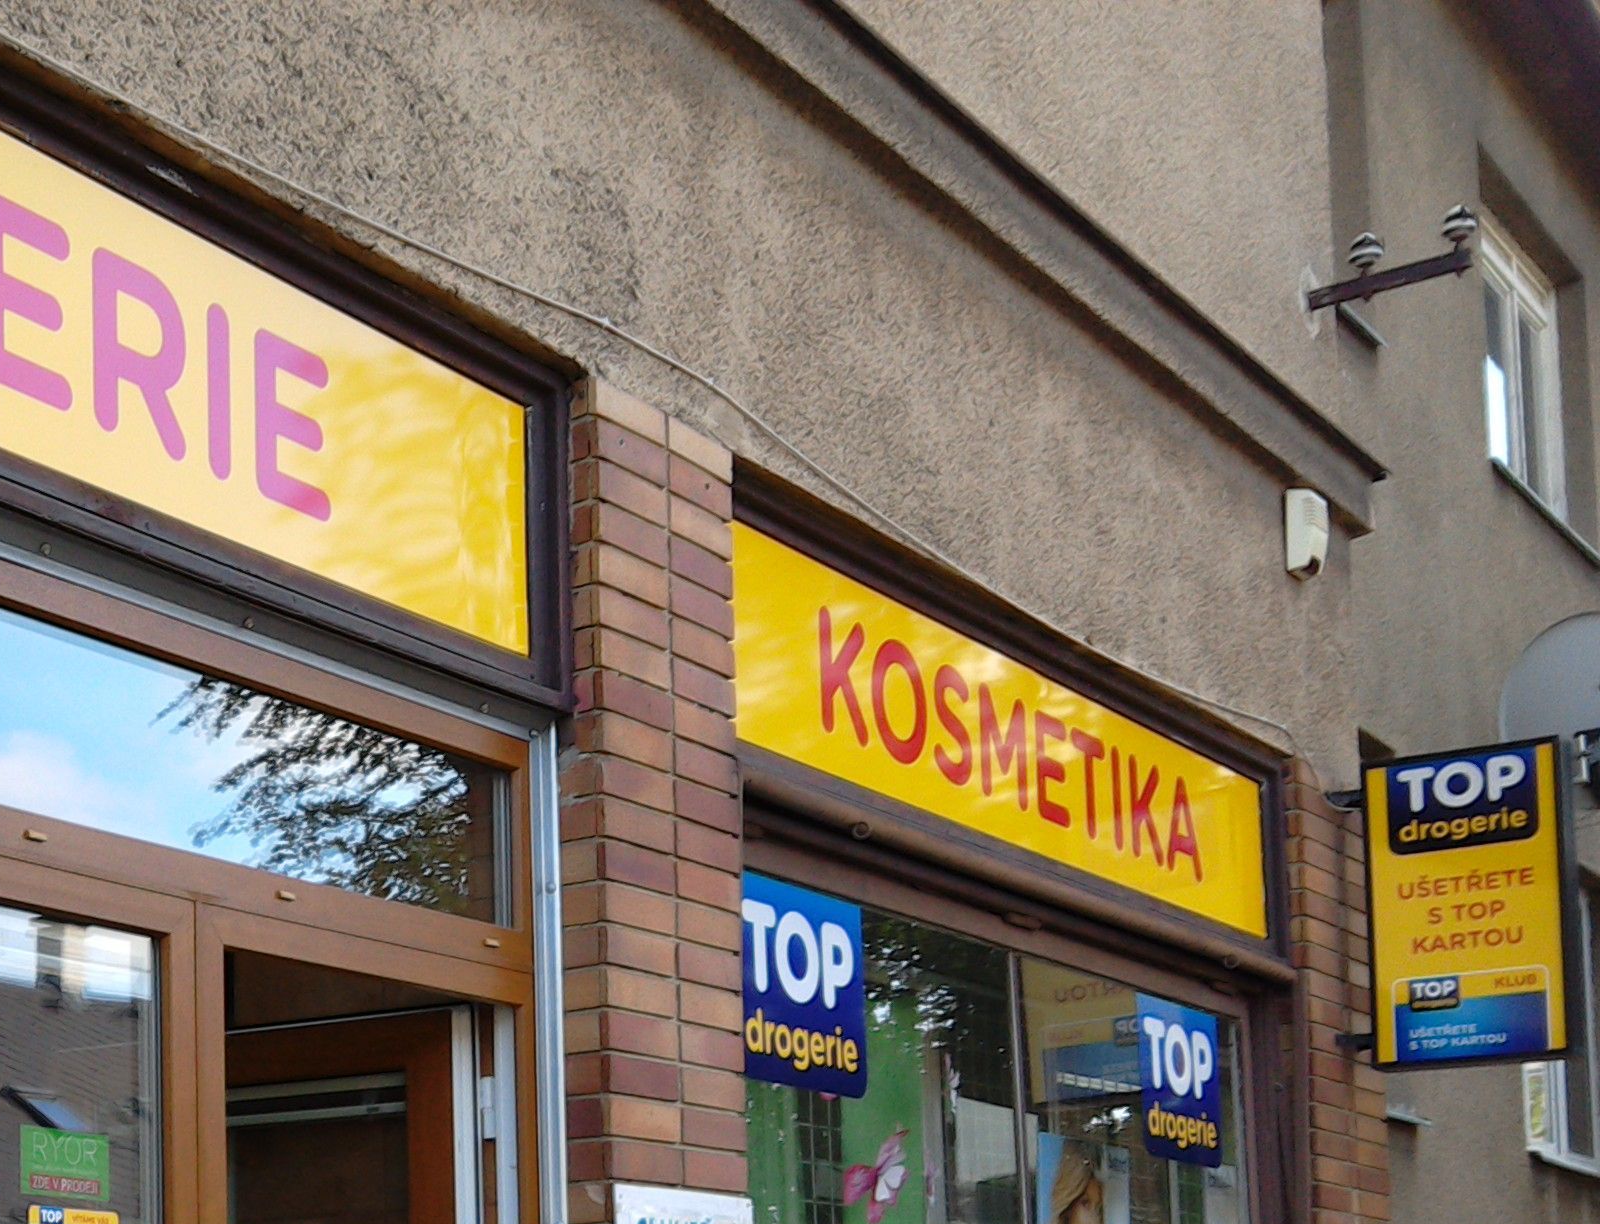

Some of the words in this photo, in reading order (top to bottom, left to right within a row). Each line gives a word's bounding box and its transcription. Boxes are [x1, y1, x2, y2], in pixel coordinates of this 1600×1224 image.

[818, 605, 1203, 884] KOSMETIKA
[1396, 754, 1526, 813] TOP
[1399, 806, 1528, 843] drogerie
[1397, 866, 1535, 900] UŠETŘETE
[1427, 906, 1443, 925] S
[1451, 898, 1505, 922] TOP
[741, 898, 854, 1009] TOP
[1411, 925, 1524, 955] KARTOU
[1410, 979, 1457, 999] TOP
[1494, 973, 1537, 988] KLUB
[745, 1006, 859, 1073] drogerie
[1408, 1039, 1419, 1051] S
[1421, 1036, 1449, 1049] TOP
[1451, 1032, 1507, 1047] KARTOU
[1143, 1015, 1213, 1100] TOP
[1148, 1100, 1218, 1149] drogerie
[32, 1131, 98, 1166] RYOR
[31, 1175, 50, 1190] ZDE
[52, 1177, 59, 1190] V
[60, 1177, 99, 1195] PRODEJI
[40, 1208, 62, 1223] TOP
